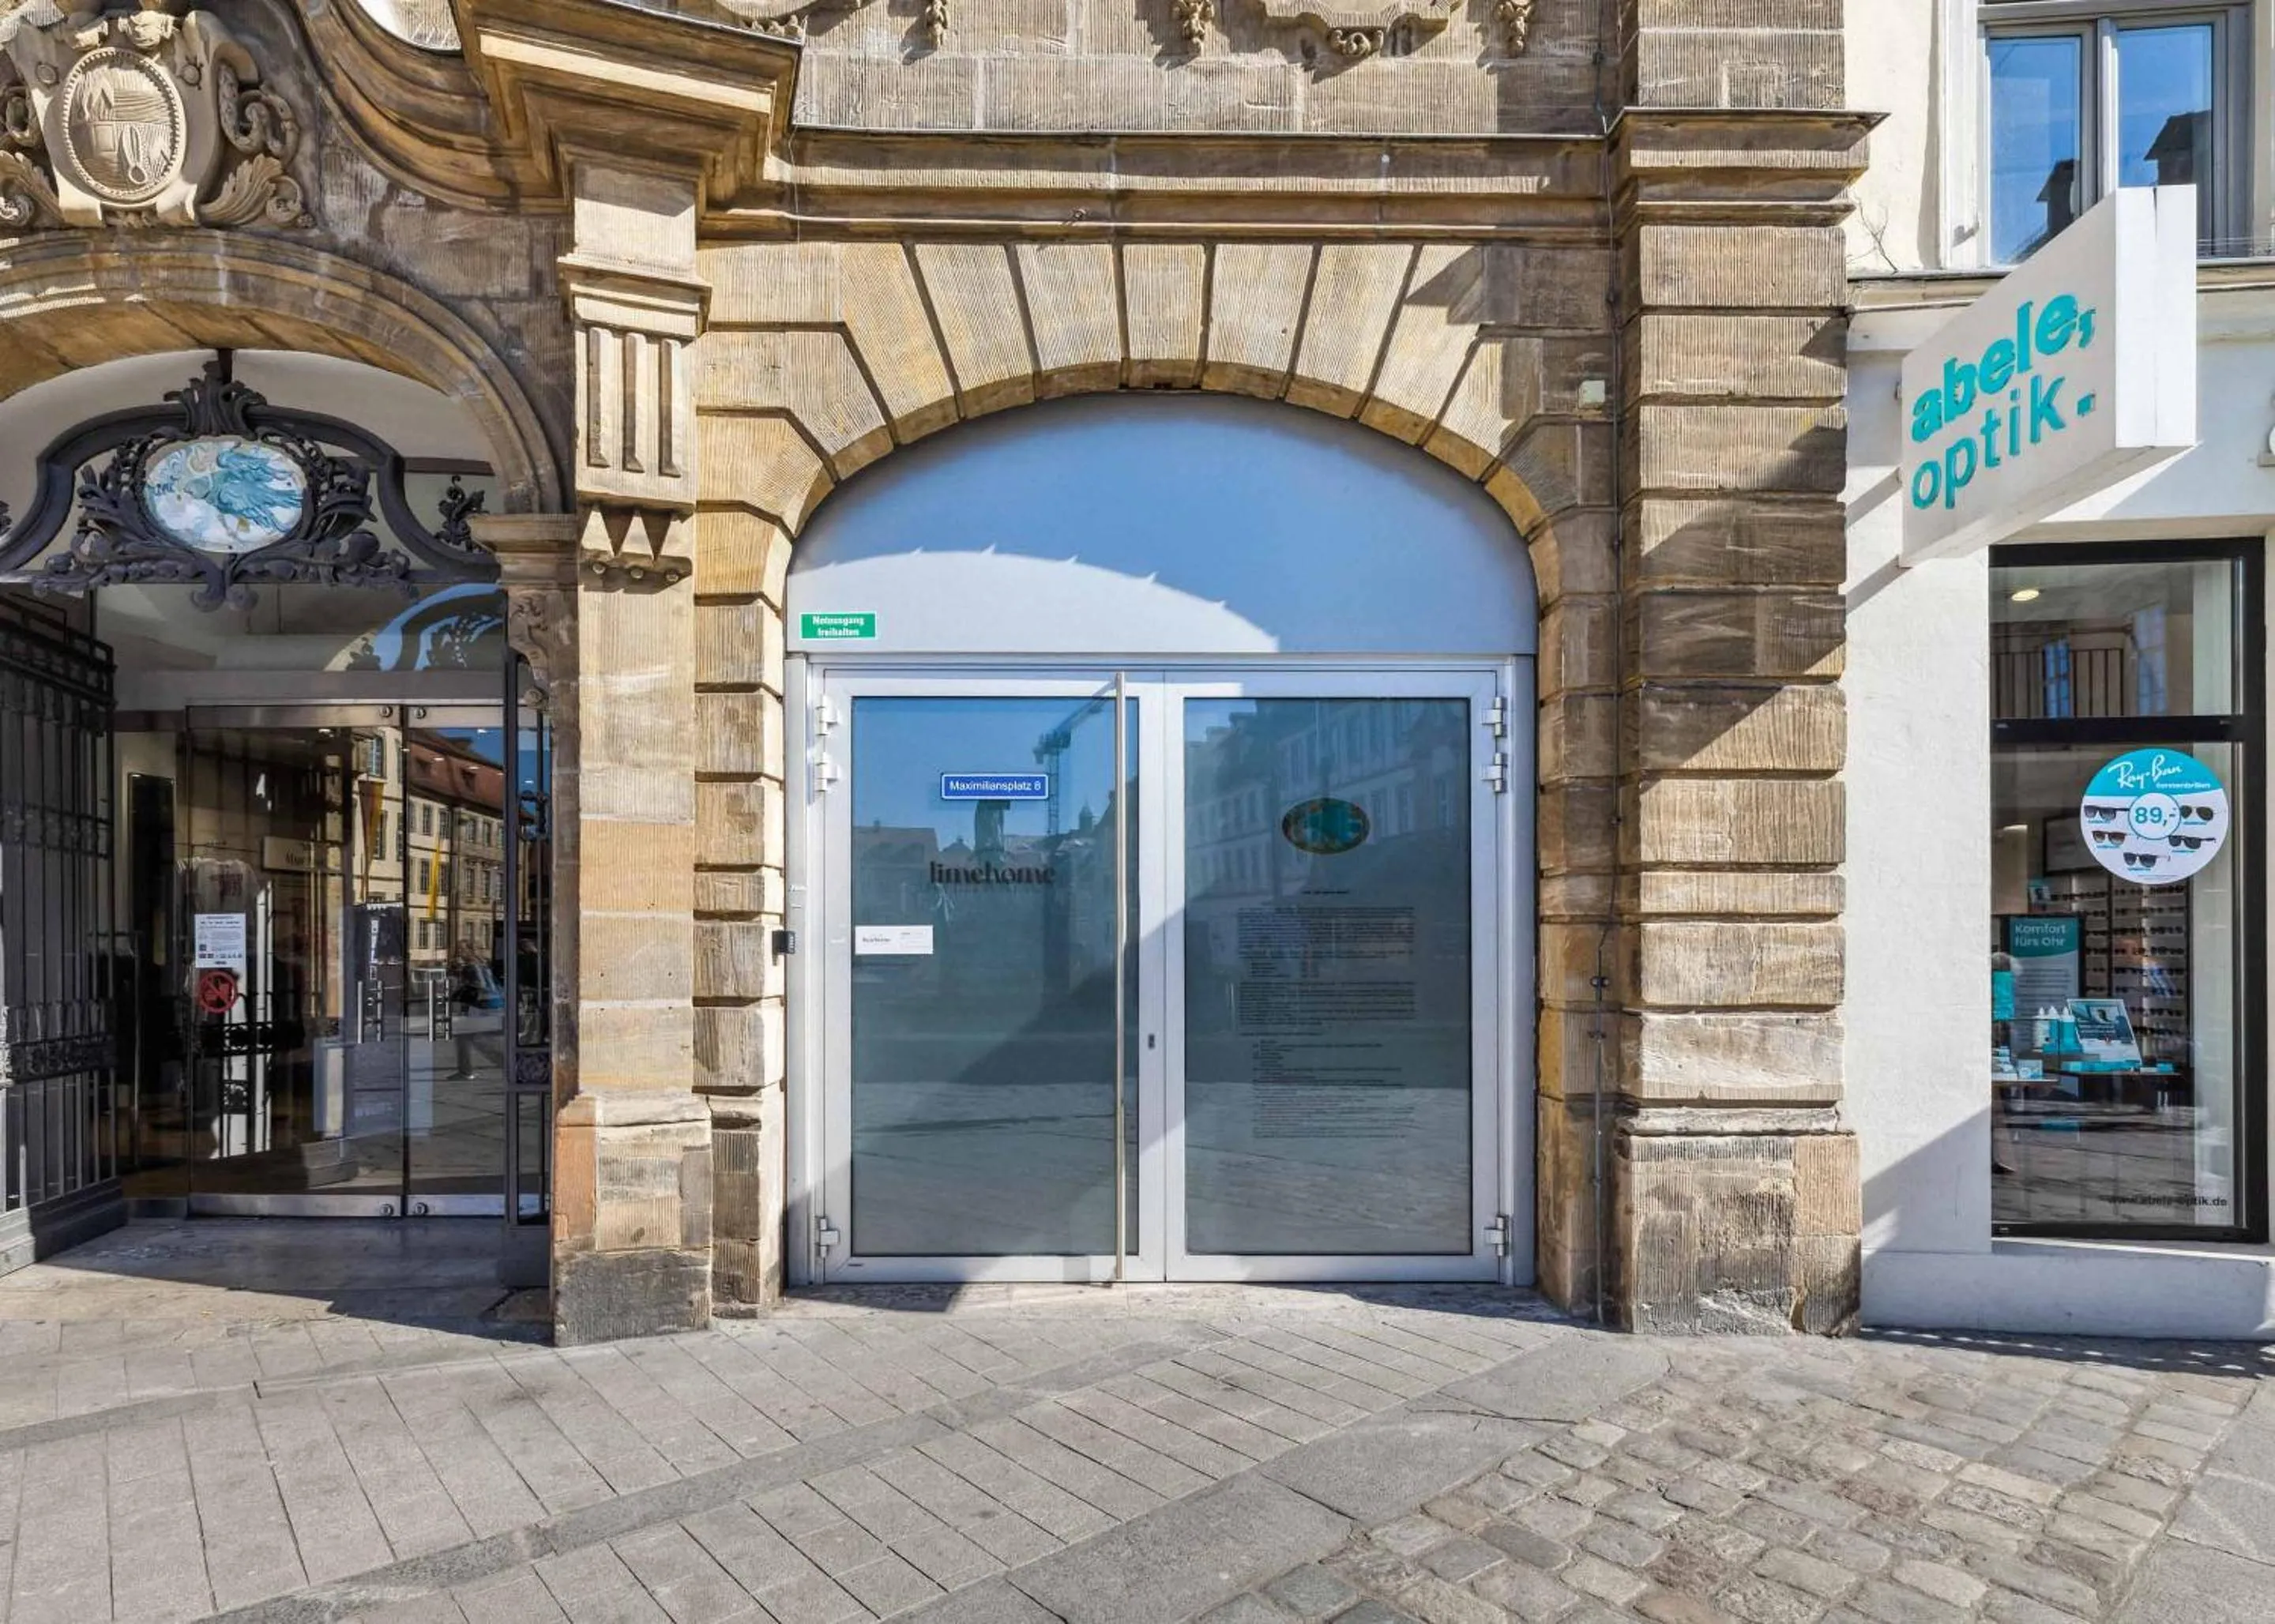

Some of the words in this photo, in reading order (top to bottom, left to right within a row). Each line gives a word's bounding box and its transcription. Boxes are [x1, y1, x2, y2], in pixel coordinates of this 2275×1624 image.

[812, 615, 865, 626] Notausgang
[817, 627, 860, 637] freihalten
[2108, 754, 2183, 789] Ray-Ban
[949, 780, 1032, 792] Maximiliansplatz
[1033, 780, 1042, 791] 8
[930, 860, 1056, 884] limehome
[2015, 923, 2066, 934] Komfort
[2015, 936, 2039, 947] fürs
[2041, 936, 2066, 946] Ohr
